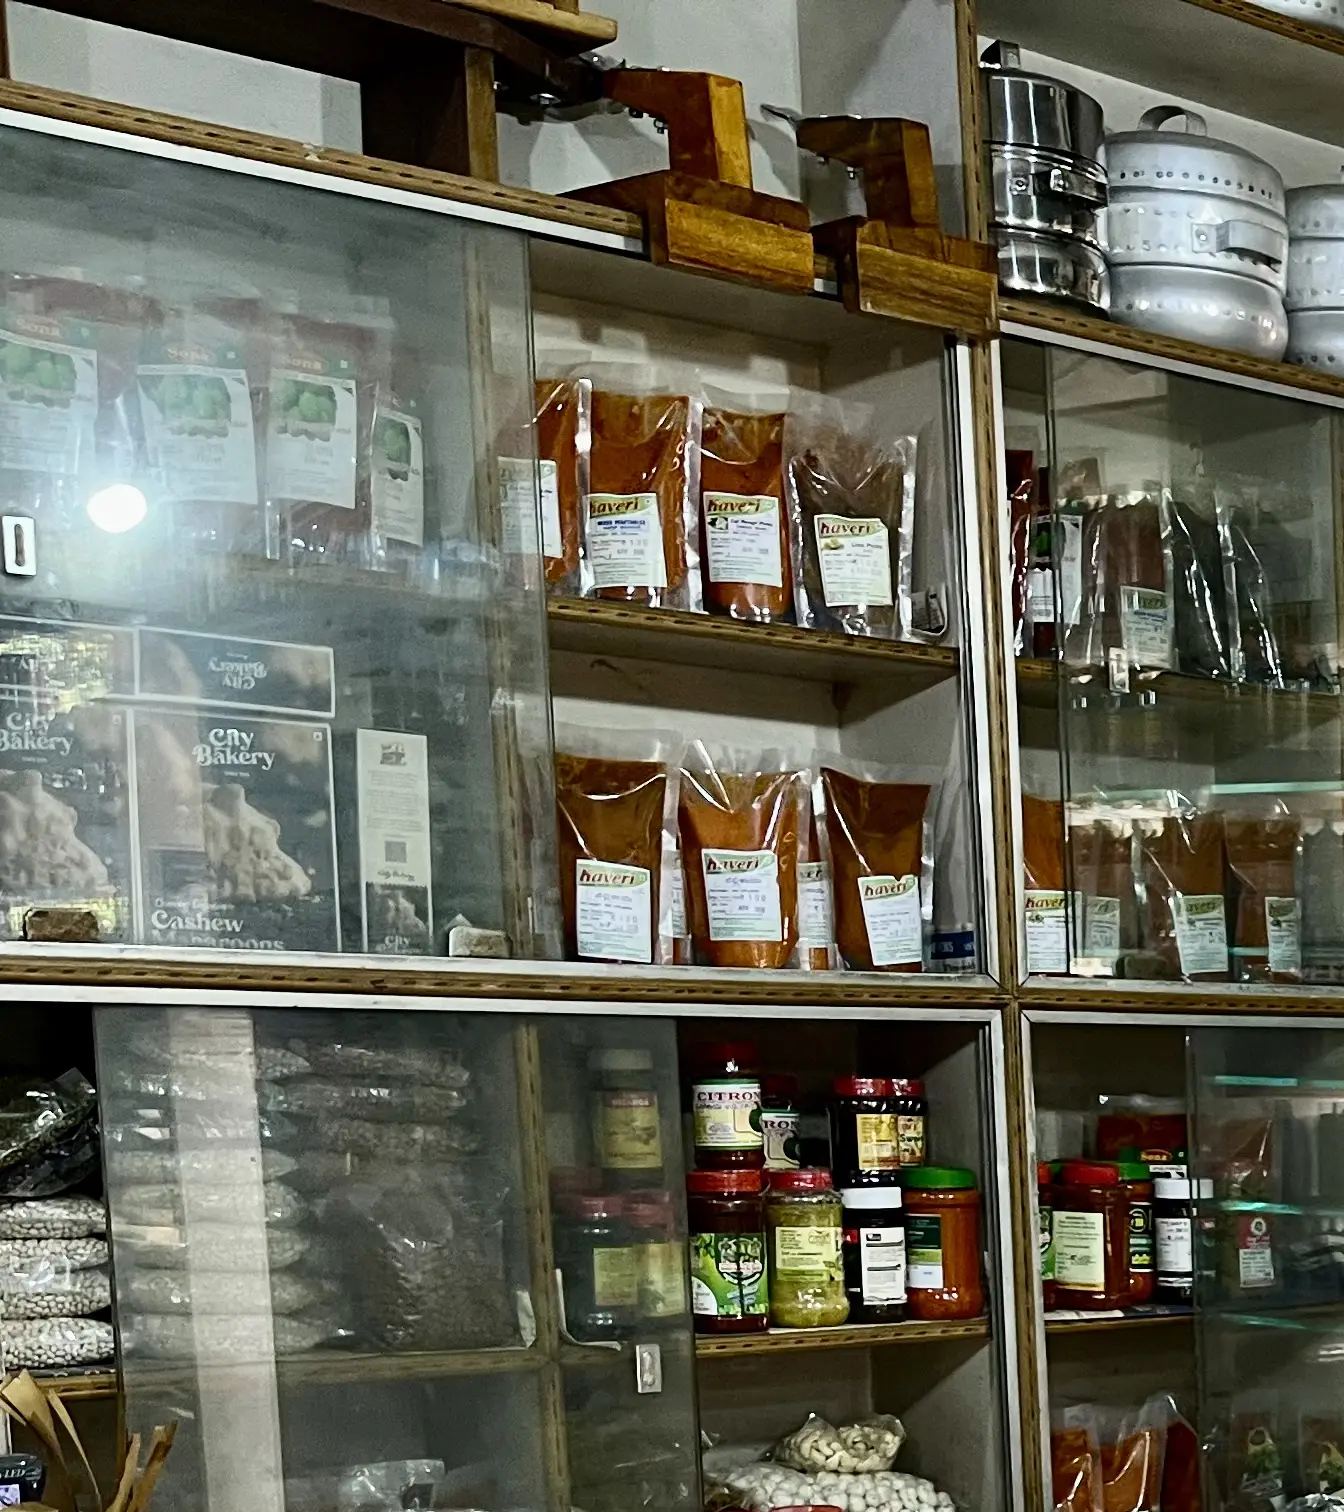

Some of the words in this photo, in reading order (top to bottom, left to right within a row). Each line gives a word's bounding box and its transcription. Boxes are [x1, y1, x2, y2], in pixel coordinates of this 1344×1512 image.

[208, 727, 255, 748] City
[191, 743, 277, 771] Bakery
[151, 909, 244, 933] Cashew
[697, 1090, 761, 1102] CITRON
